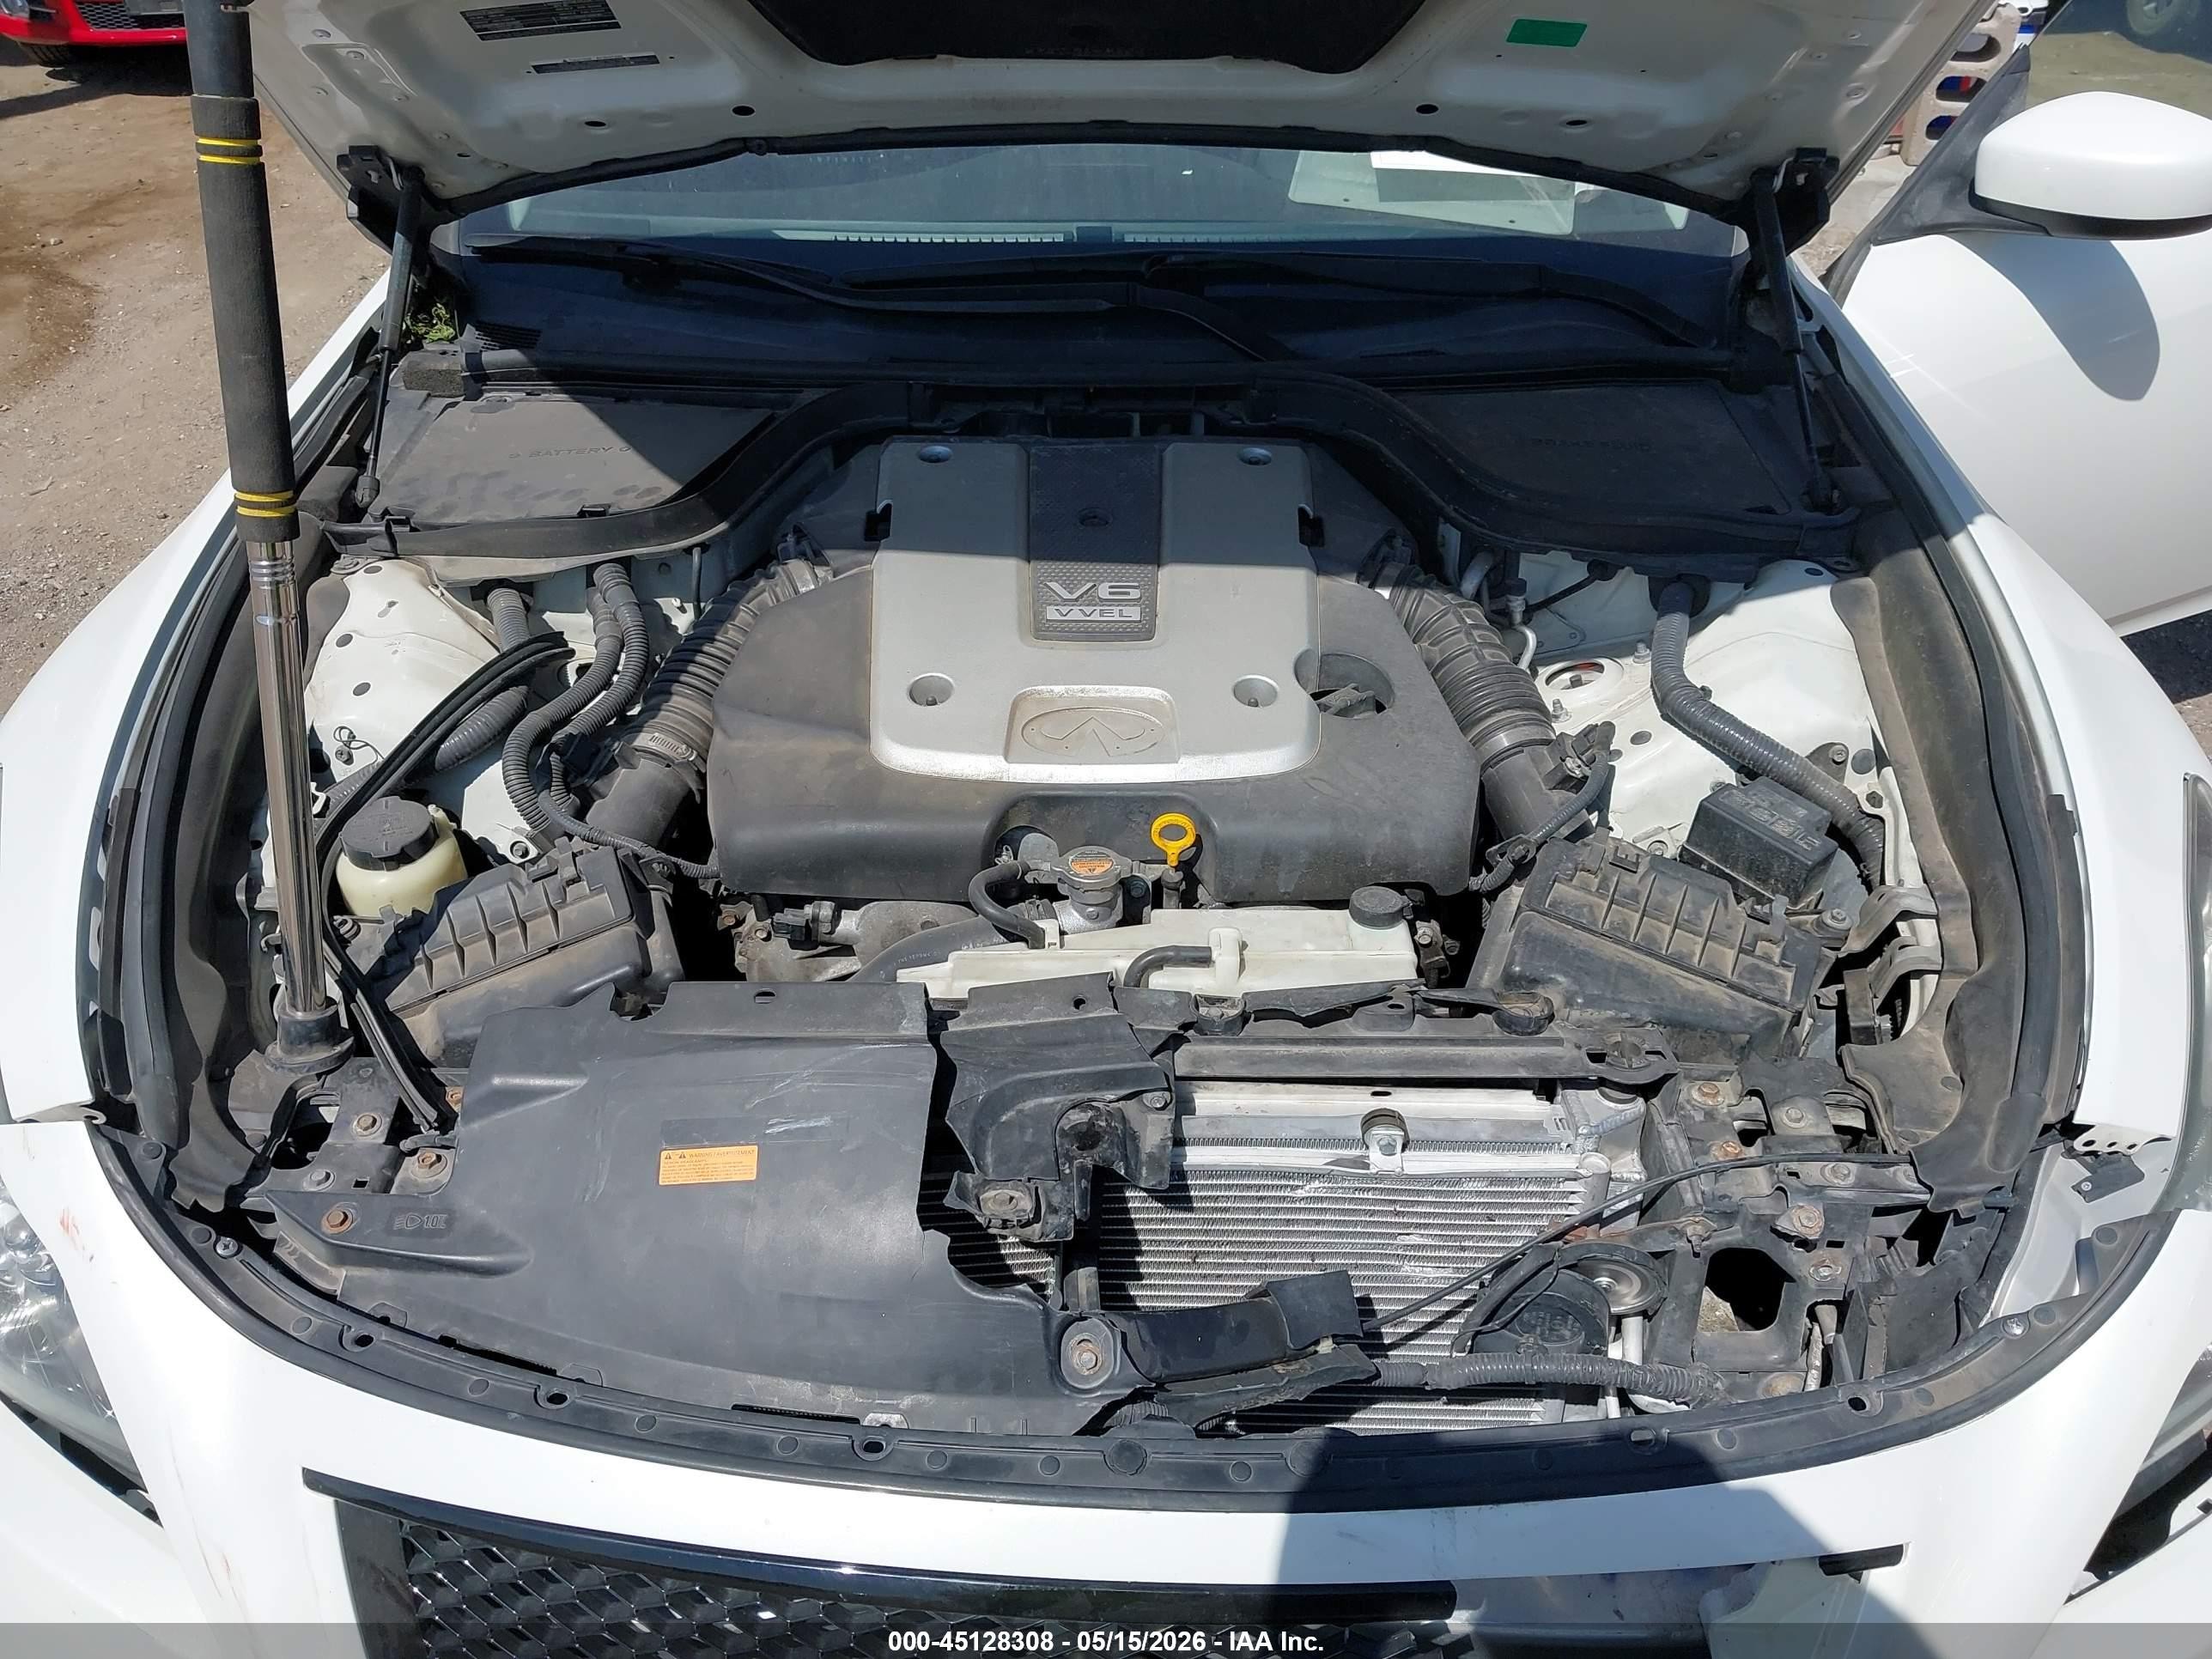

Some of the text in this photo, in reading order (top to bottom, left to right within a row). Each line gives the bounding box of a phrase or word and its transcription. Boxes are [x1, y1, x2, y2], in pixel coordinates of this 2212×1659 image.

[528, 446, 614, 458] BATTERY
[1043, 581, 1143, 603] V6
[1054, 608, 1133, 618] VVEL
